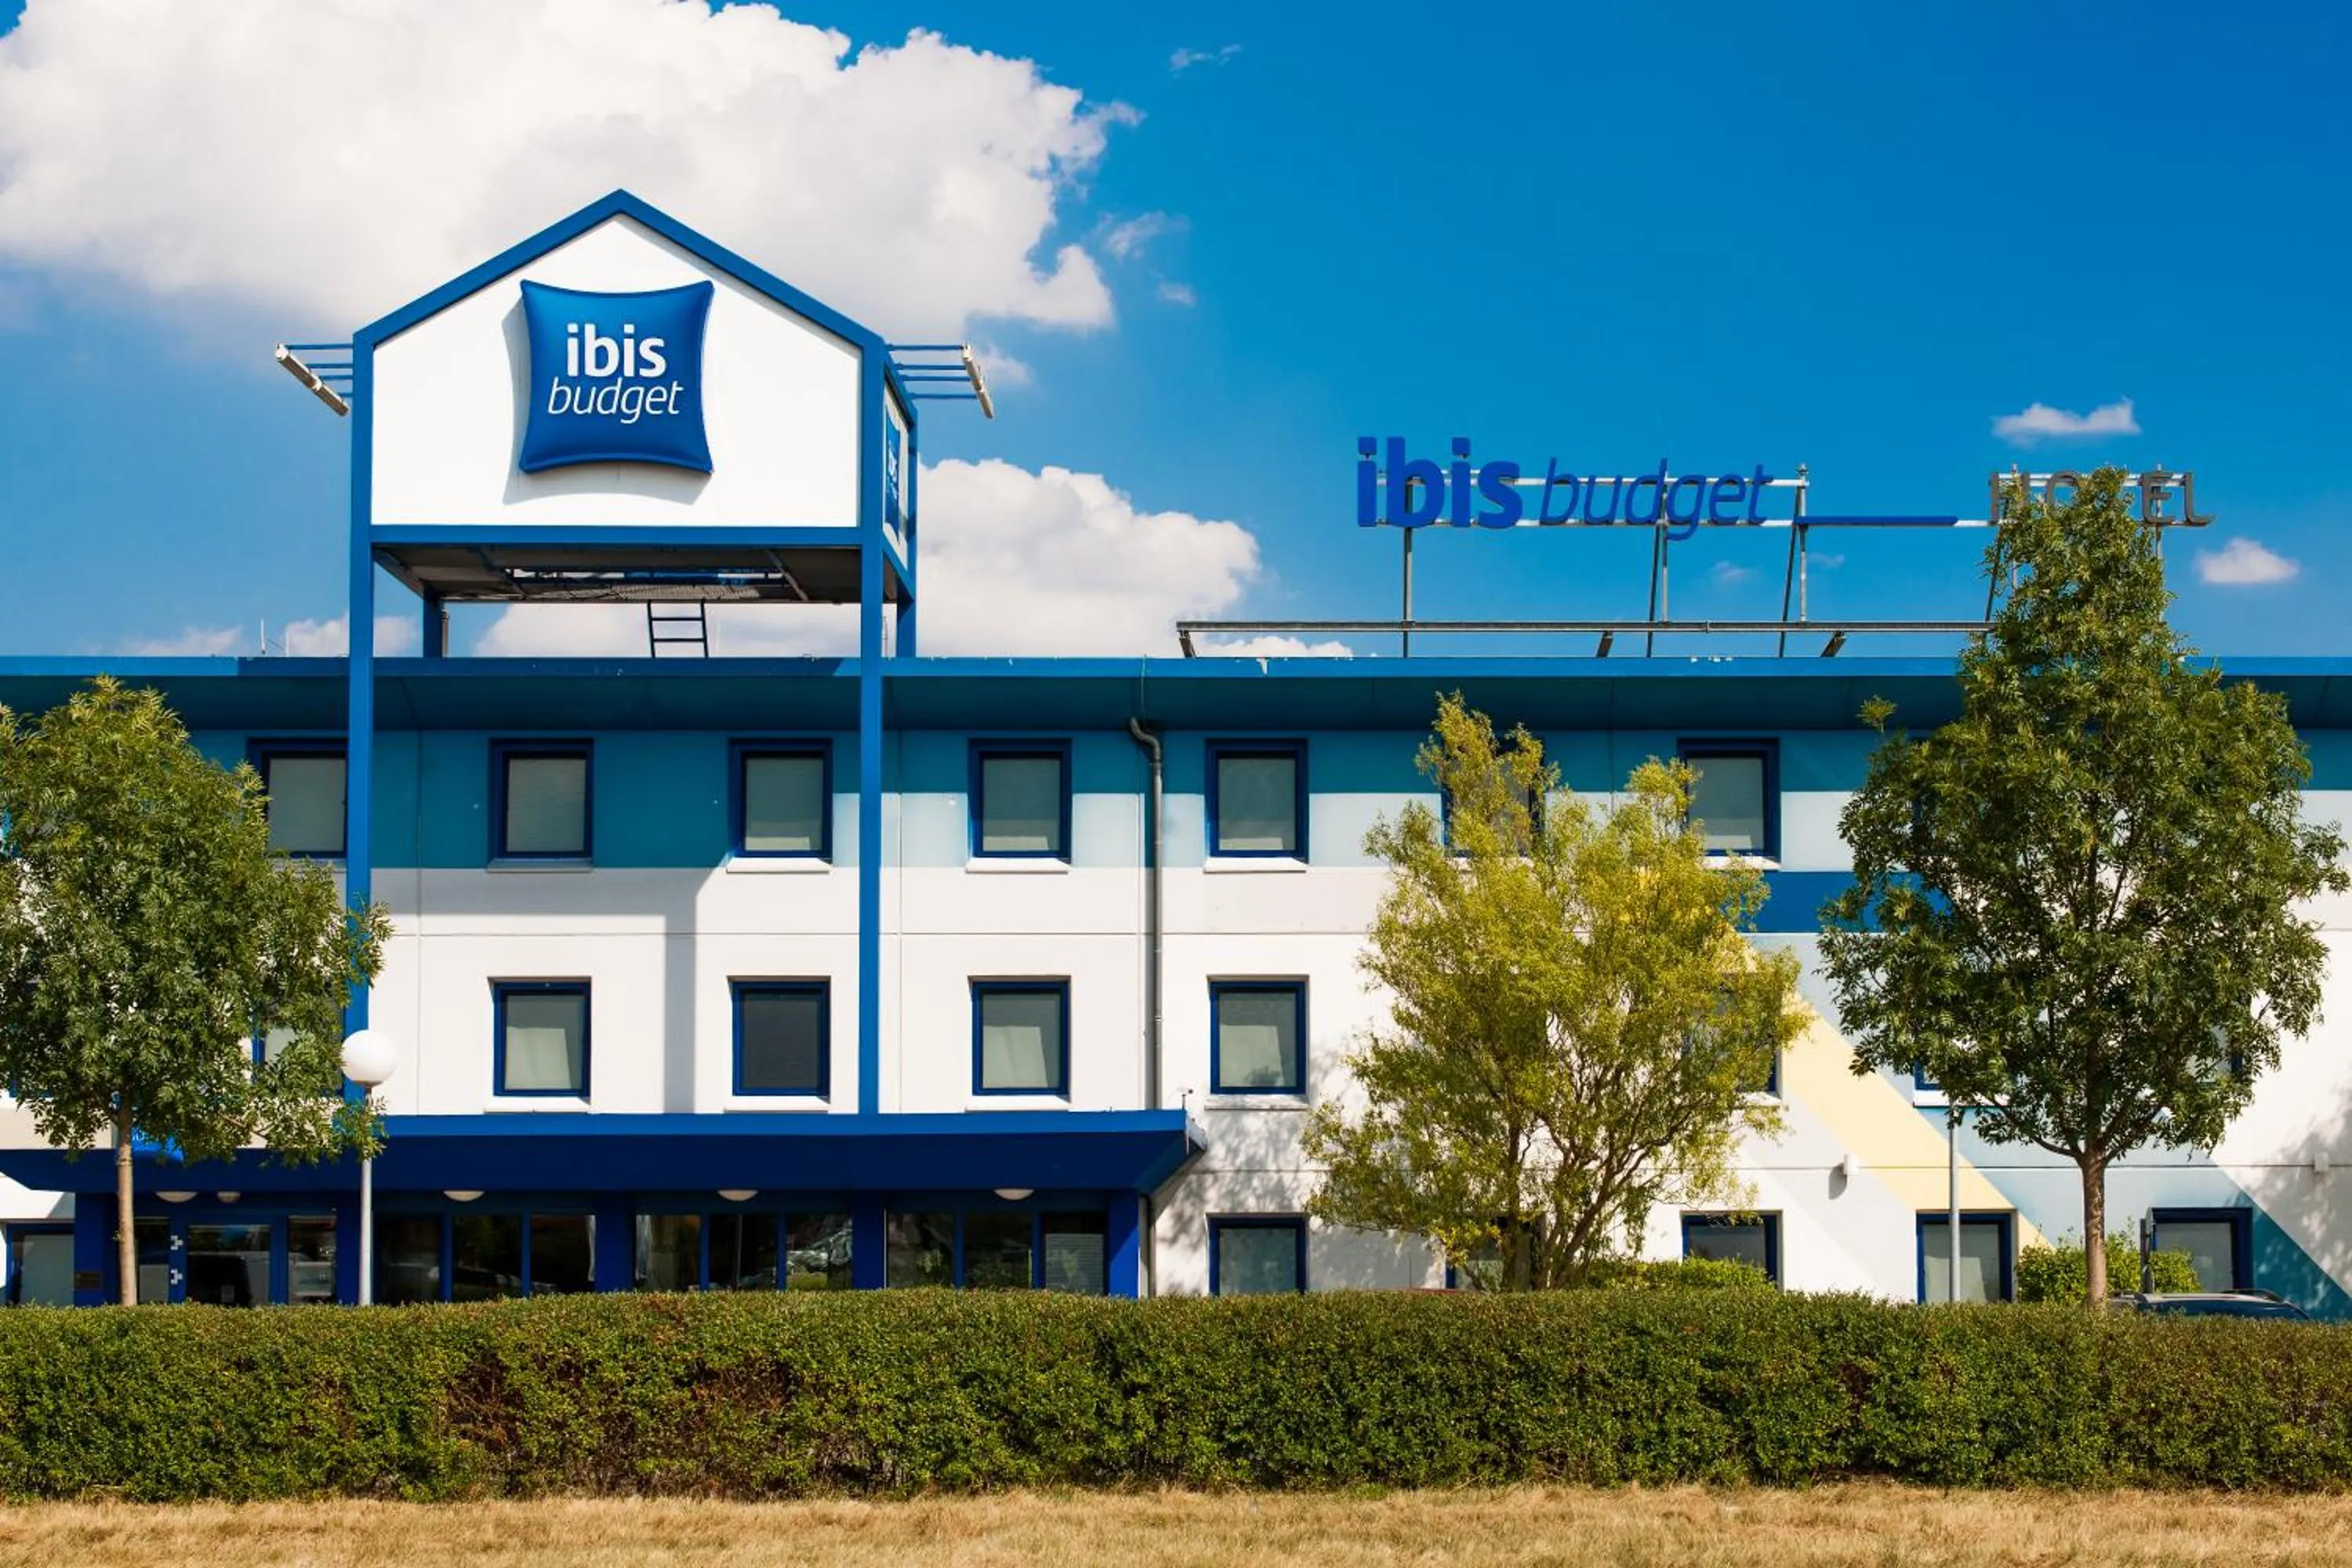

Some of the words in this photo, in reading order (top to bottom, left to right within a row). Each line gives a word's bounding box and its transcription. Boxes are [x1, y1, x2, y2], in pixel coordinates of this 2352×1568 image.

[566, 323, 666, 377] ibis
[548, 376, 684, 423] budget
[1357, 436, 1523, 528] ibis
[1540, 457, 1775, 541] budget
[1989, 470, 2216, 526] HOEL
